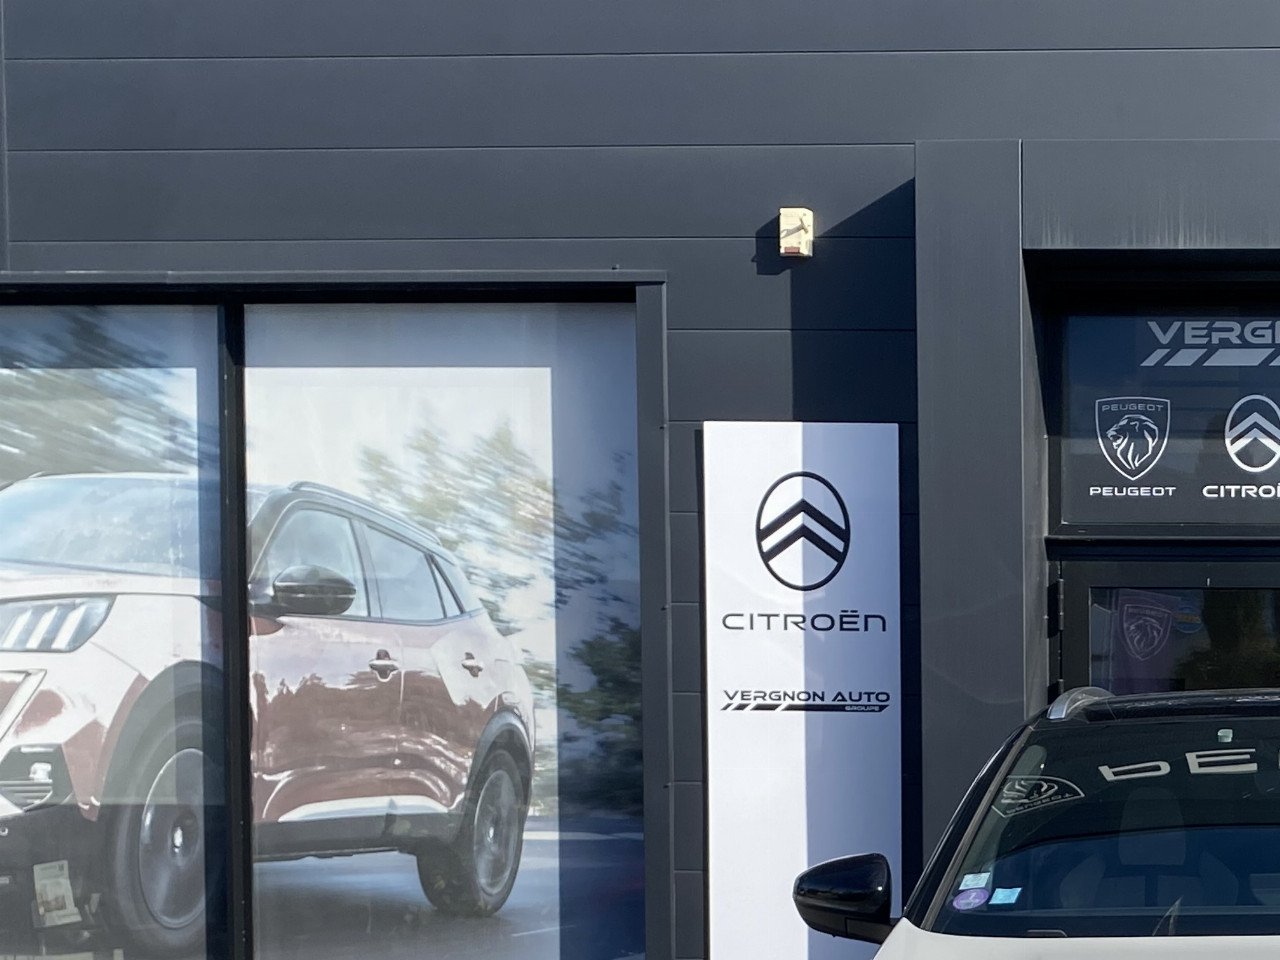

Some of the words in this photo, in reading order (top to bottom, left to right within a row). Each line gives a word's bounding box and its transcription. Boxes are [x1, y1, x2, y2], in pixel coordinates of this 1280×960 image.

[1101, 402, 1164, 413] PEUGEOT
[1089, 486, 1177, 497] PEUGEOT
[722, 610, 887, 632] CITROËN
[723, 690, 825, 702] VERGNON
[831, 691, 891, 703] AUTO
